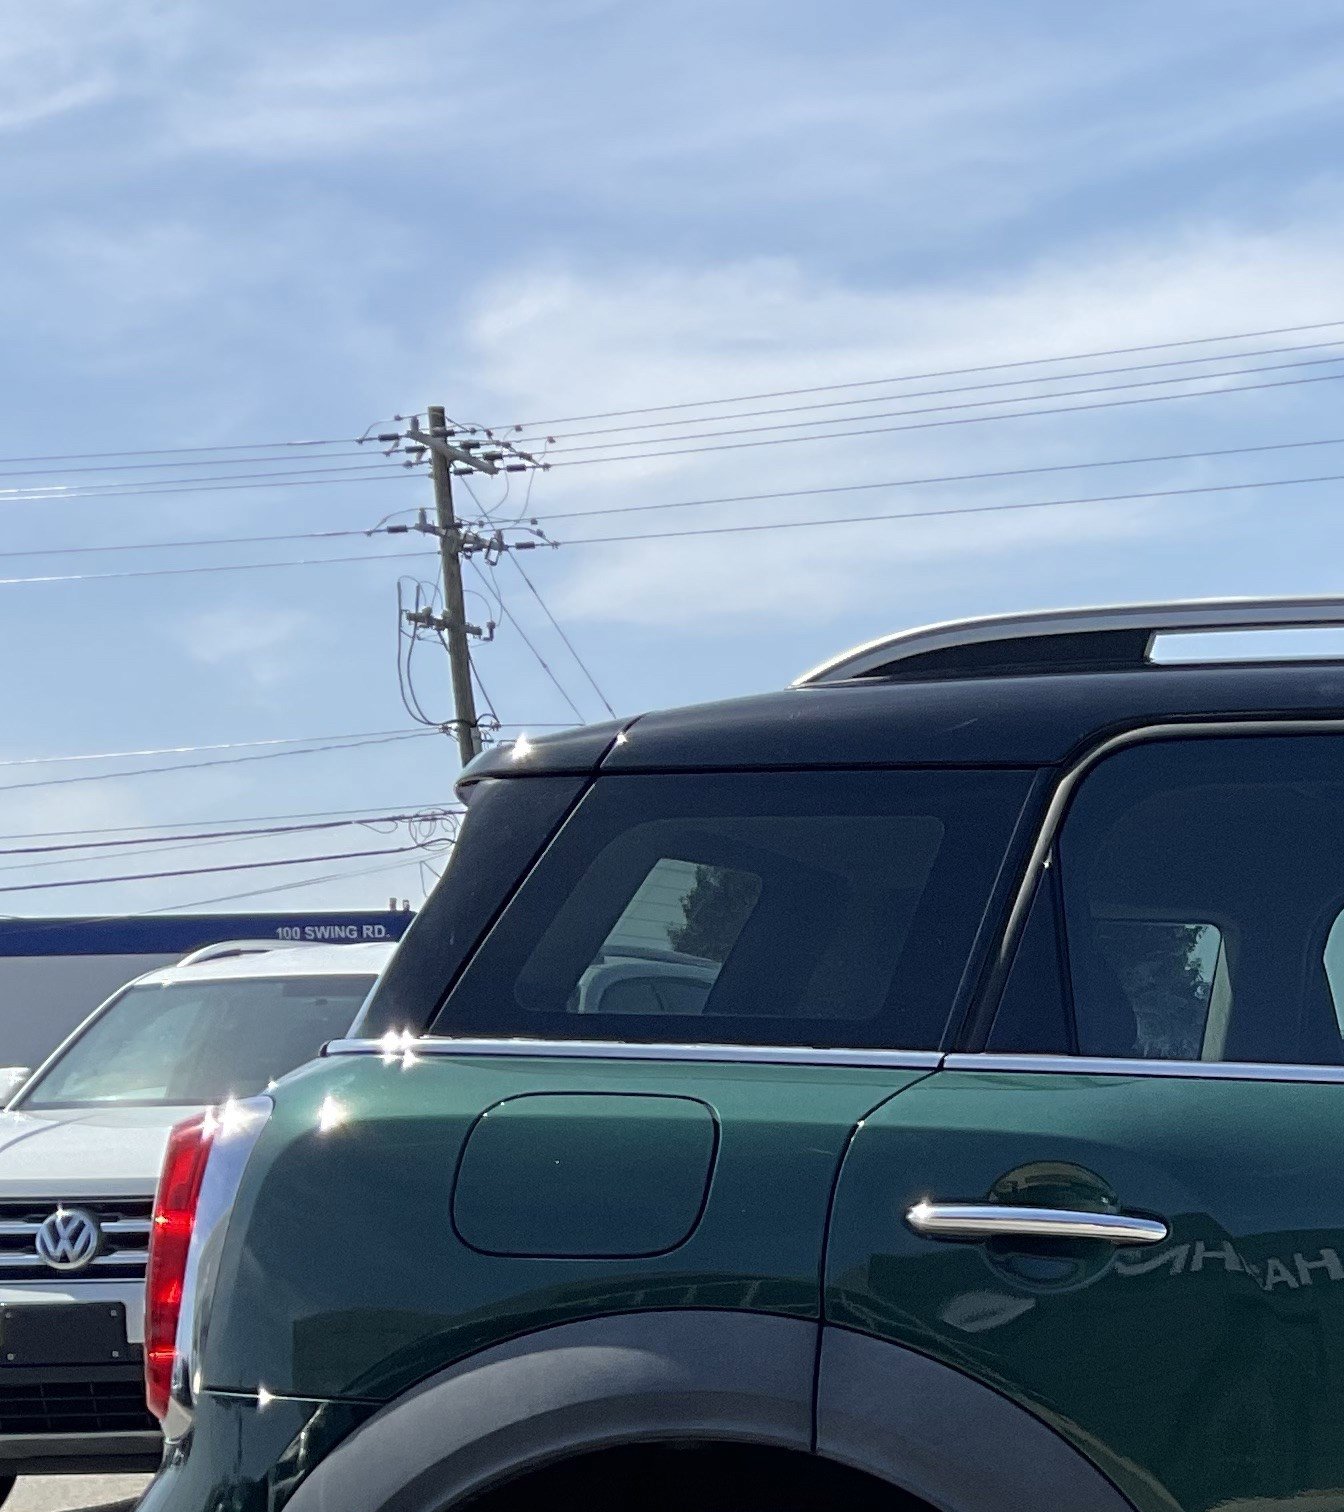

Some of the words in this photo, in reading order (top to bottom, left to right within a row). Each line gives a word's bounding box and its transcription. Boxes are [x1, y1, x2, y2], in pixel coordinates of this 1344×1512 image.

[276, 926, 301, 940] 100
[304, 925, 358, 939] SWING
[362, 924, 391, 938] RD.
